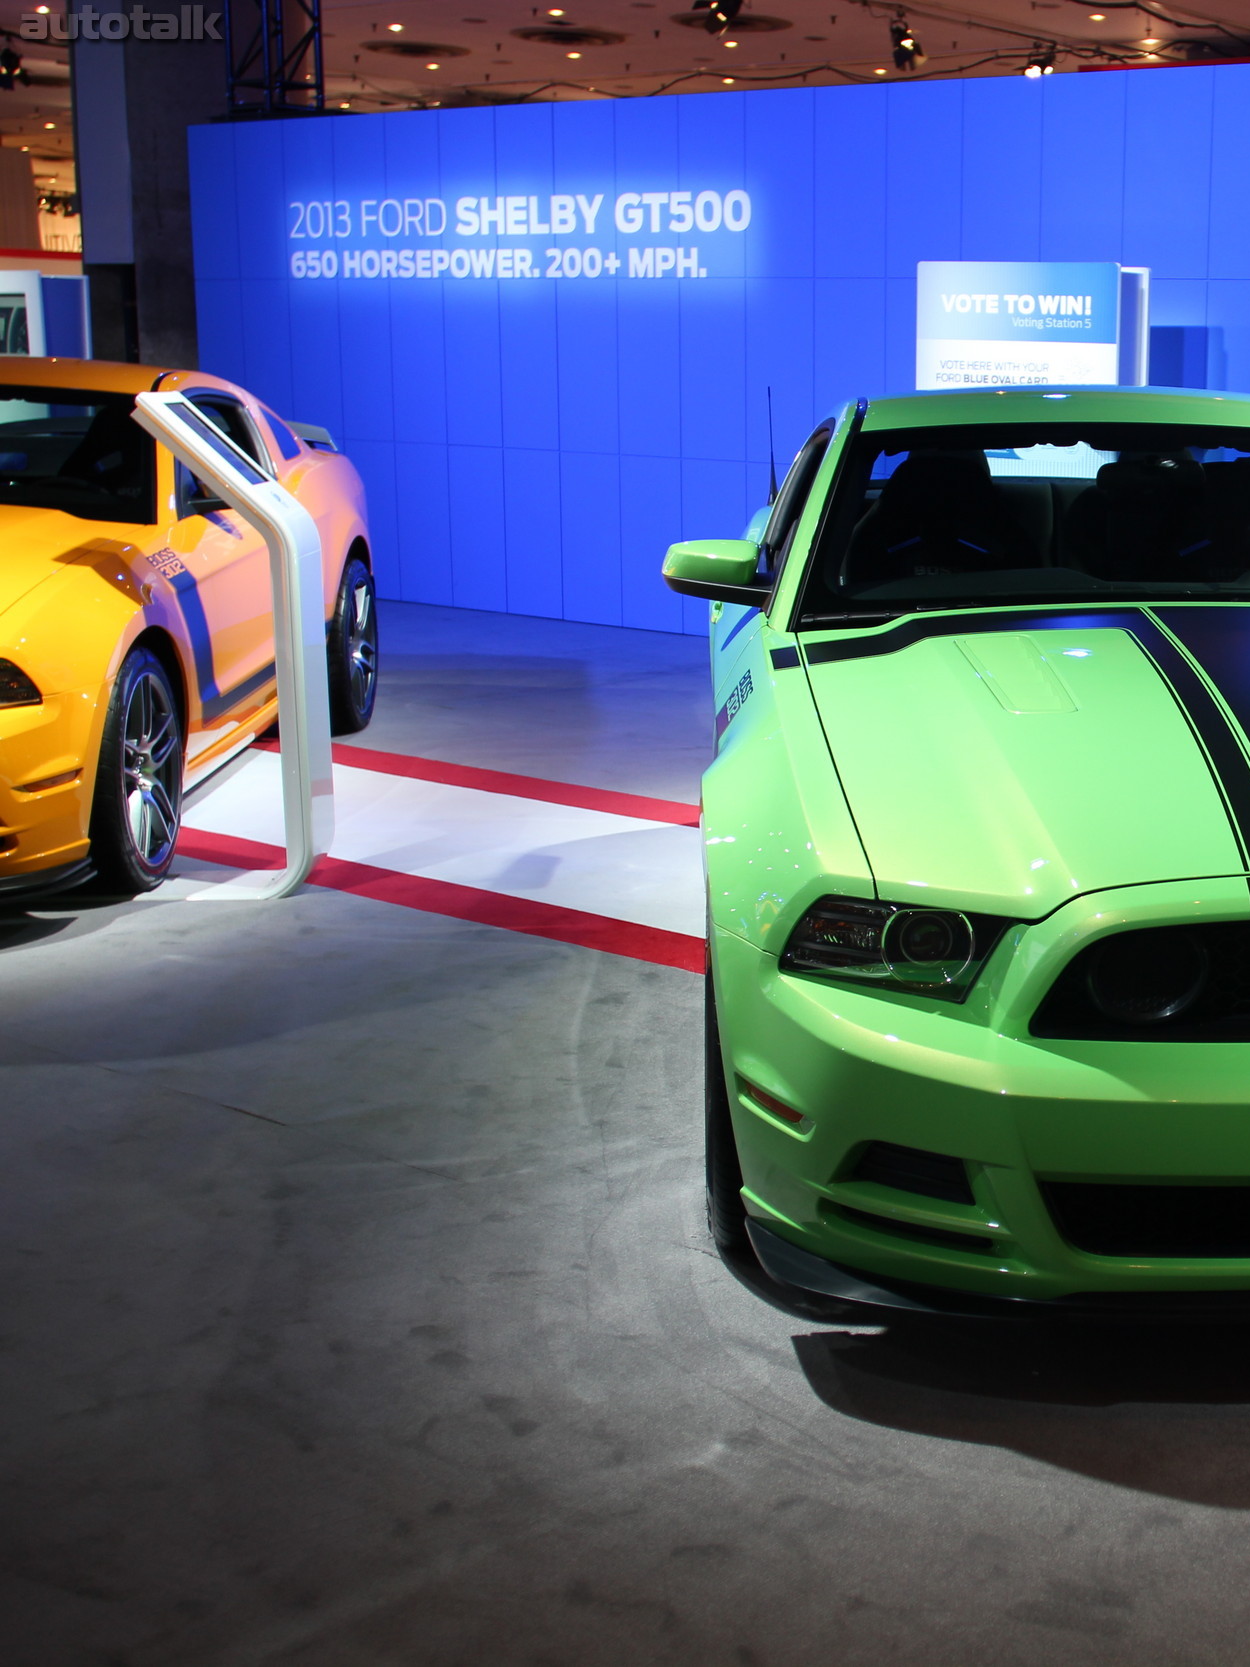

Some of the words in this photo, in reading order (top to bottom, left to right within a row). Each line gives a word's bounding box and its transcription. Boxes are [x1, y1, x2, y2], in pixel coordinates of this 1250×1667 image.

[289, 200, 352, 239] 2013
[360, 199, 447, 237] FORD
[455, 194, 604, 236] SHELBY
[614, 189, 751, 234] GT500
[291, 250, 338, 279] 650
[343, 248, 540, 279] HORSEPOWER.
[545, 247, 621, 278] 200+
[628, 246, 707, 278] MPH.
[941, 294, 999, 314] VOTE
[1004, 294, 1036, 315] TO
[1038, 295, 1092, 316] WIN!
[1012, 316, 1043, 329] Voting
[1045, 317, 1083, 329] Station
[1085, 318, 1092, 329] 5
[939, 360, 965, 370] VOTE
[967, 360, 992, 371] HERE
[995, 361, 1020, 371] WITH
[1023, 362, 1049, 372] YOUR
[936, 372, 961, 383] FORD
[963, 374, 989, 384] BLUE
[991, 375, 1016, 385] OVAL
